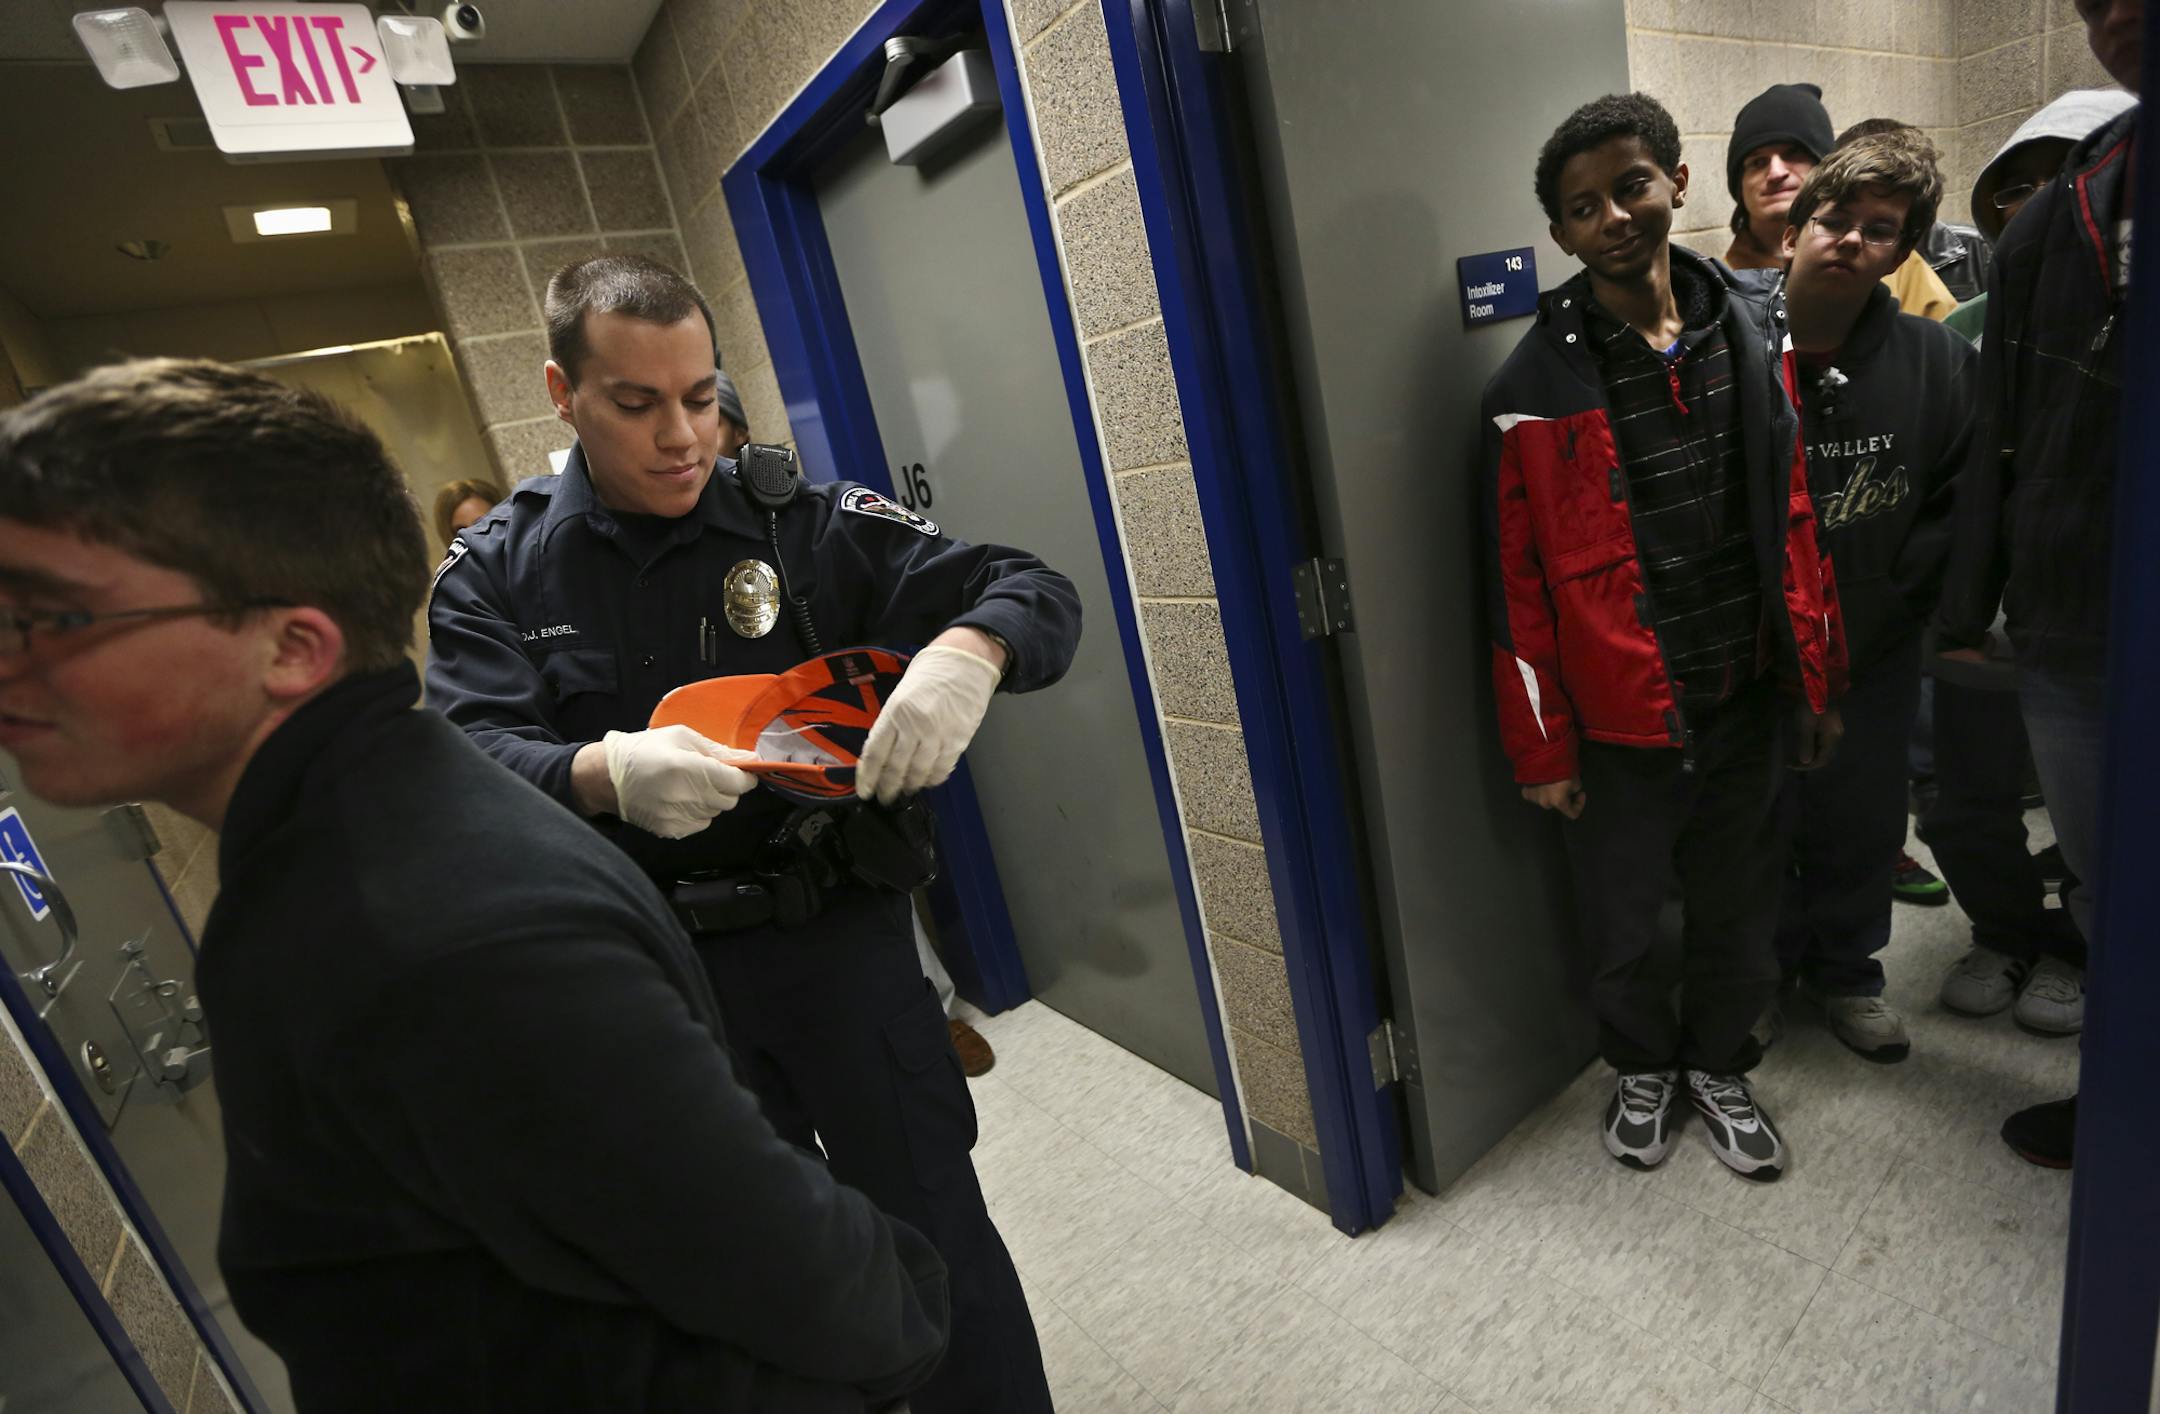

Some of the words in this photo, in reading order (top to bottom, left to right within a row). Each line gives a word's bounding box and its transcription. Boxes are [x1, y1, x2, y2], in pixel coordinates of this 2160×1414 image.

[213, 15, 362, 106] EXIT
[1505, 256, 1523, 272] 143
[1467, 281, 1505, 300] Intoxilizer
[1469, 303, 1495, 319] Room
[1819, 433, 1895, 458] VALLEY
[901, 463, 933, 512] J6
[541, 624, 577, 638] ENGEL
